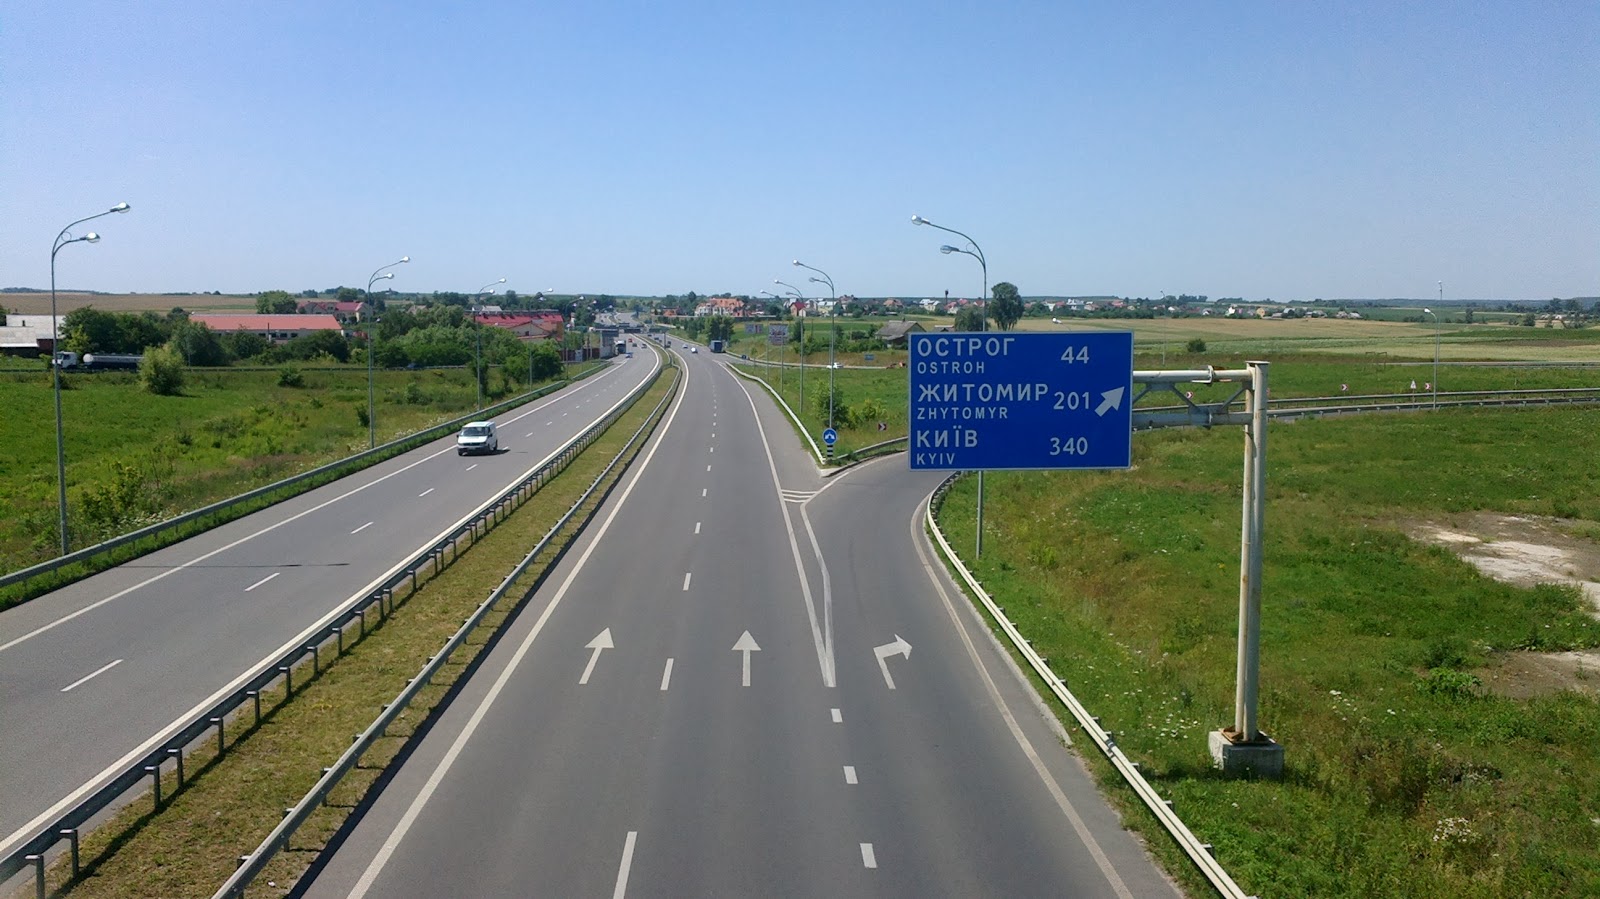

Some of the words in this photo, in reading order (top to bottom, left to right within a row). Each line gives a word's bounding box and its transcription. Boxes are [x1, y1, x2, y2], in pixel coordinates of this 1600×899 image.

[917, 338, 1015, 356] ОСТРОГ
[1061, 346, 1089, 364] 44
[917, 362, 985, 374] OSTROH
[918, 384, 1049, 402] ЖИТОМИР
[1053, 392, 1090, 410] 201
[917, 407, 1008, 420] ZHYTOMYR
[917, 426, 978, 448] КИЇВ
[1049, 437, 1088, 455] 340
[917, 453, 955, 465] KYIV
